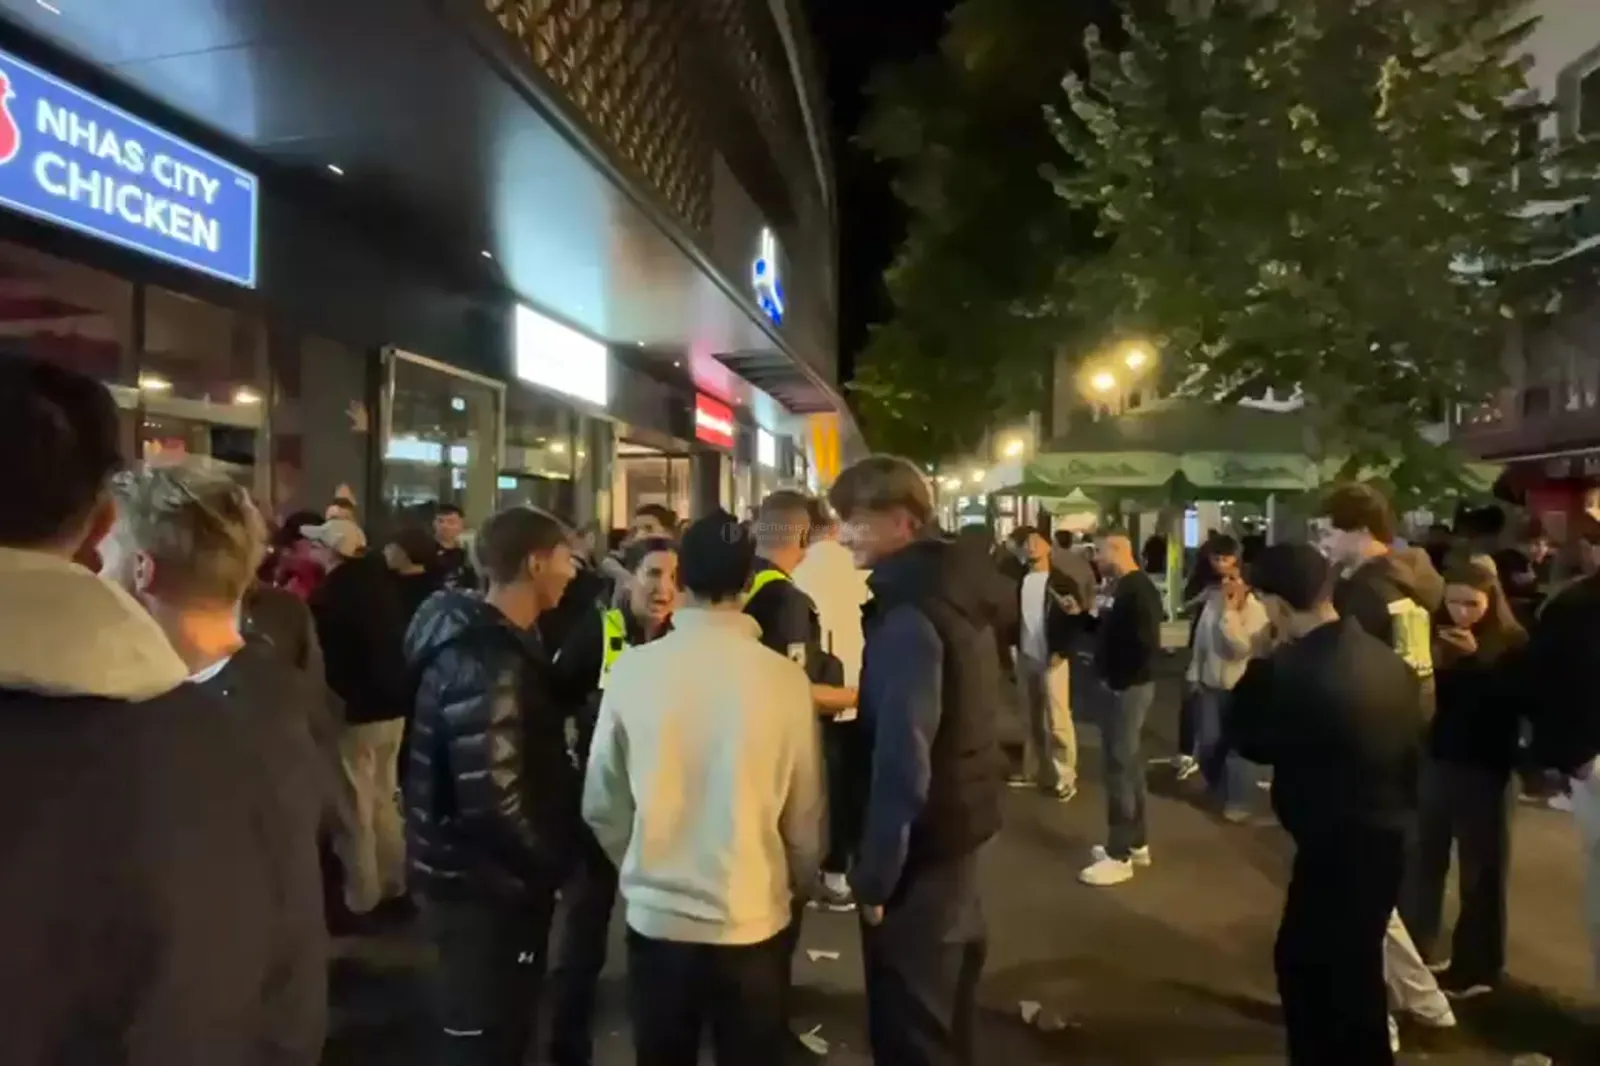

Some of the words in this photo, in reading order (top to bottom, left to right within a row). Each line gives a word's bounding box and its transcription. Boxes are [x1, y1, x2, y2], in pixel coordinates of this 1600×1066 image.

[34, 151, 221, 253] CHICKEN
[36, 98, 146, 174] NHAS
[152, 154, 221, 205] CITY
